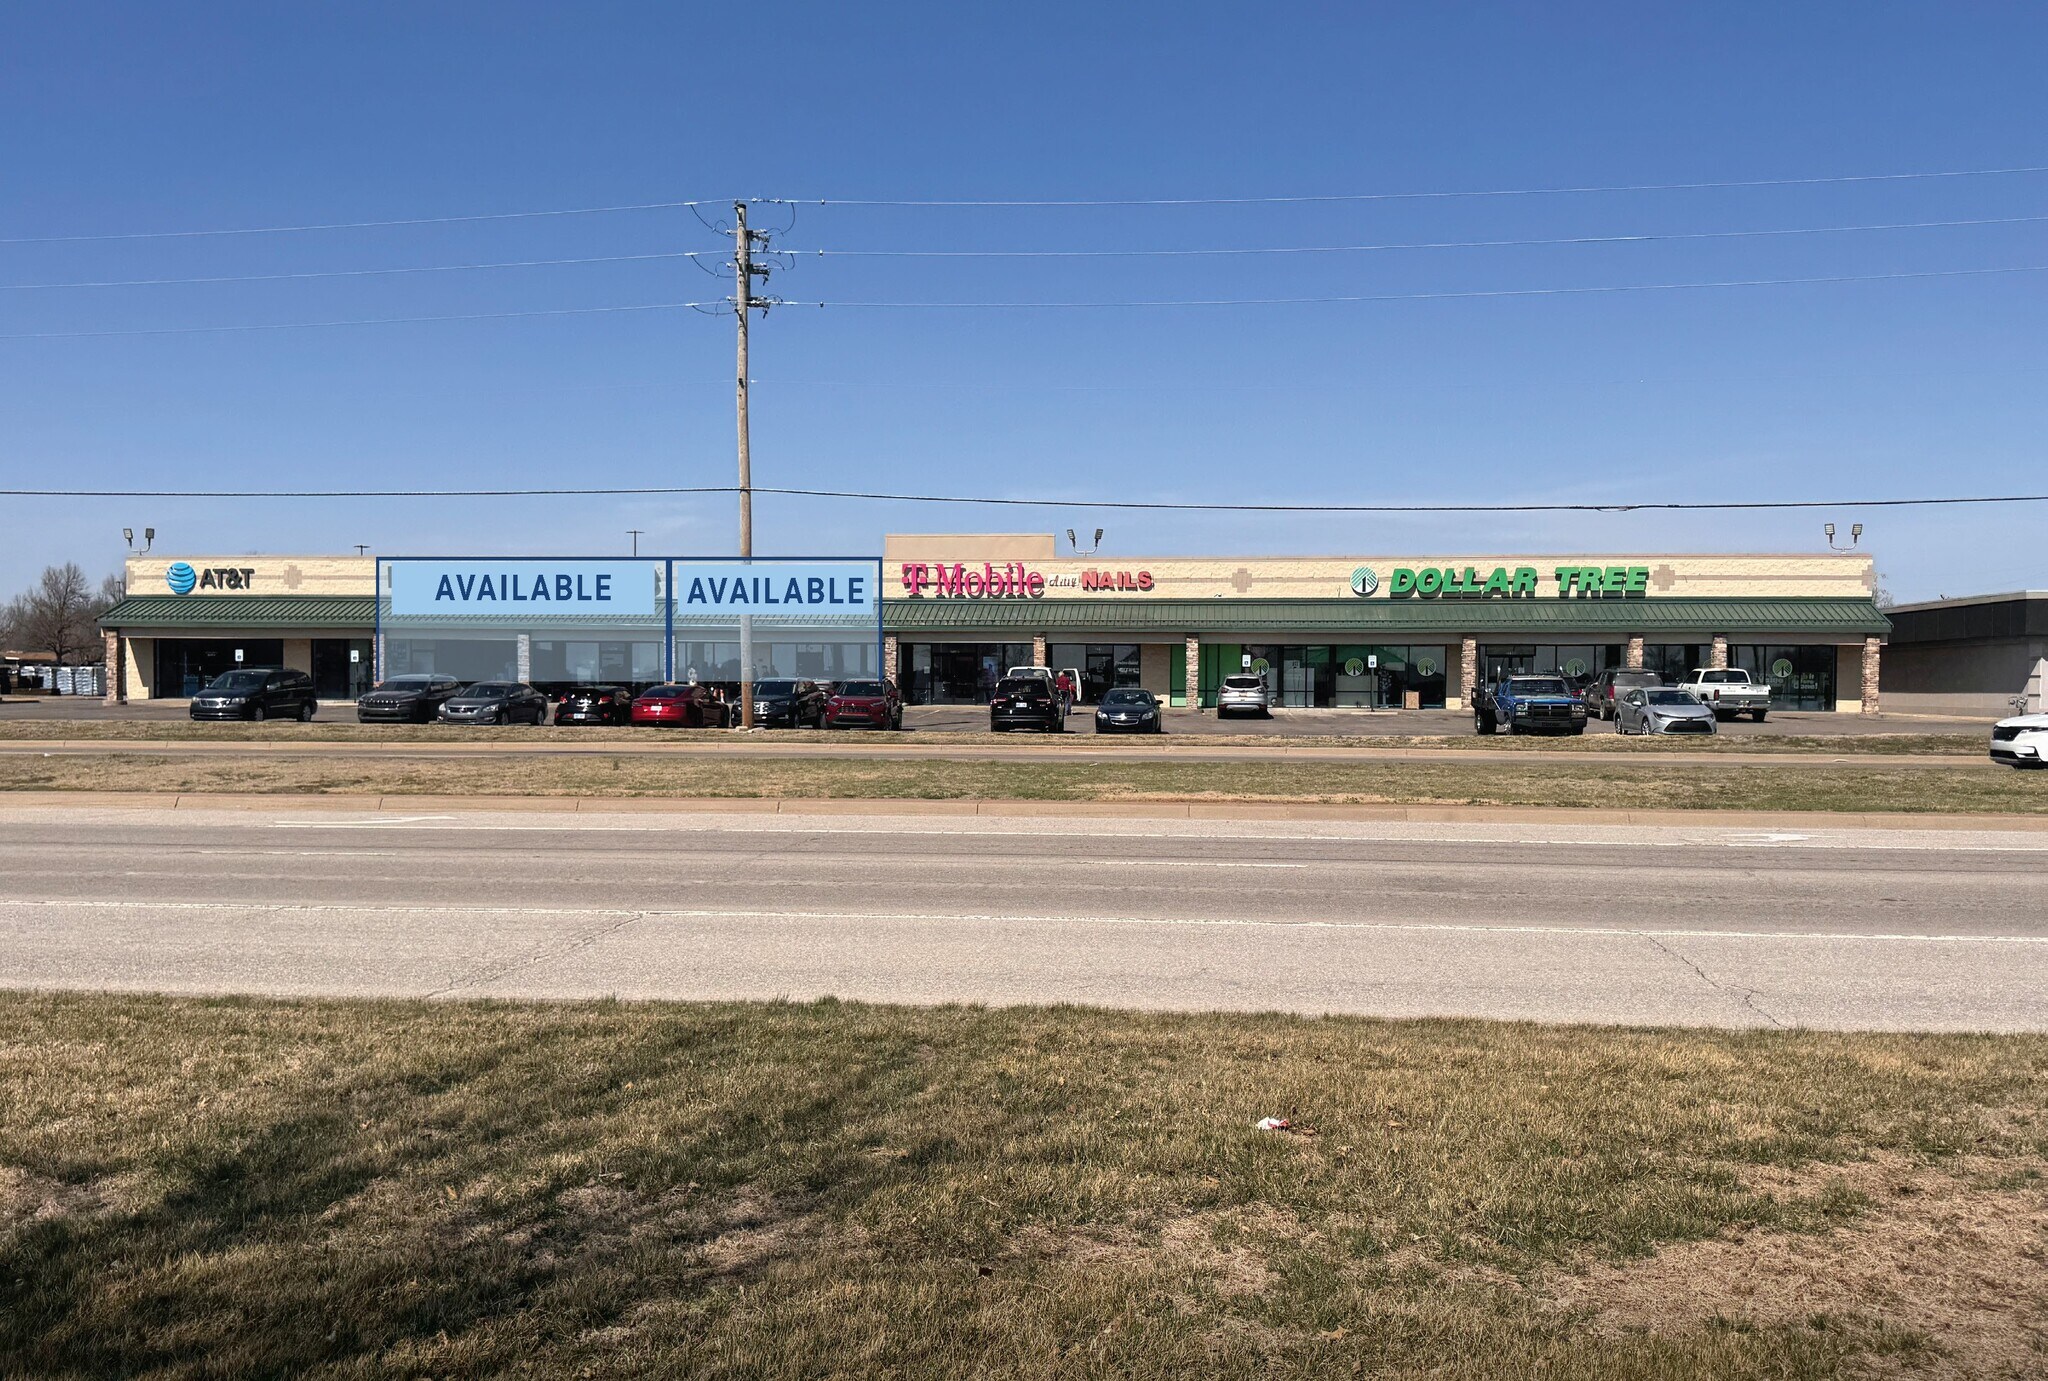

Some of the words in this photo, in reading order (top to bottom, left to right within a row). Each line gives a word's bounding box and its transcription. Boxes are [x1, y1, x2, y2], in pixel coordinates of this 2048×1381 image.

[200, 568, 255, 589] AT&T
[1082, 571, 1153, 590] NAILS
[1389, 567, 1537, 595] DOLLAR
[1555, 566, 1649, 593] TREE
